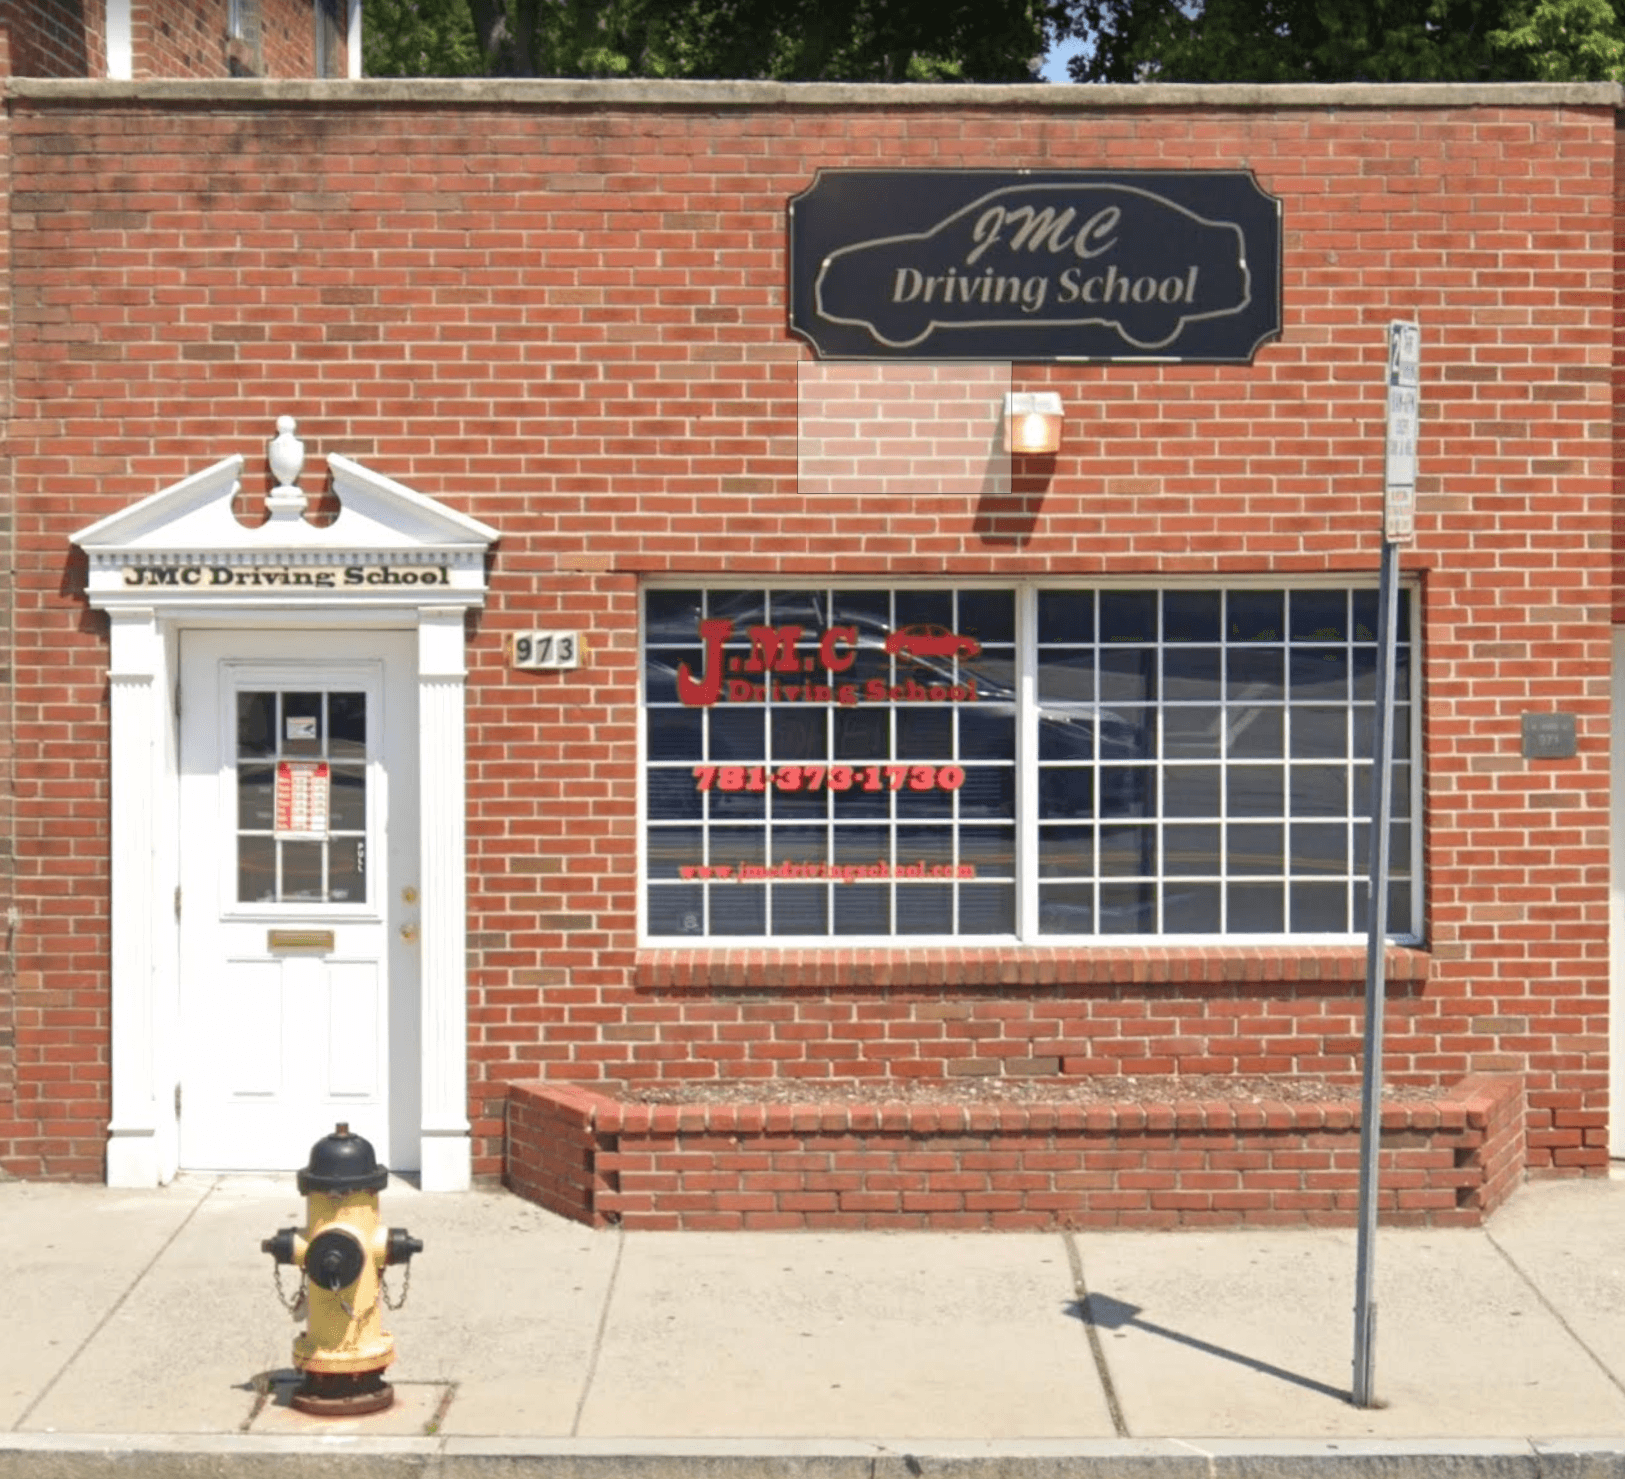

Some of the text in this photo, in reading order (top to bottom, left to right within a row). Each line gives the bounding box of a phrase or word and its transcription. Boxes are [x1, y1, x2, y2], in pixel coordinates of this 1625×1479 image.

[965, 205, 1121, 265] JMC
[892, 265, 1199, 312] Driving School
[125, 566, 450, 588] JMC Driving School
[515, 636, 575, 662] 973
[727, 678, 979, 707] Driving School
[692, 765, 967, 792] 781-373-1730
[678, 859, 977, 885] www.jmcdrivingschool.com
